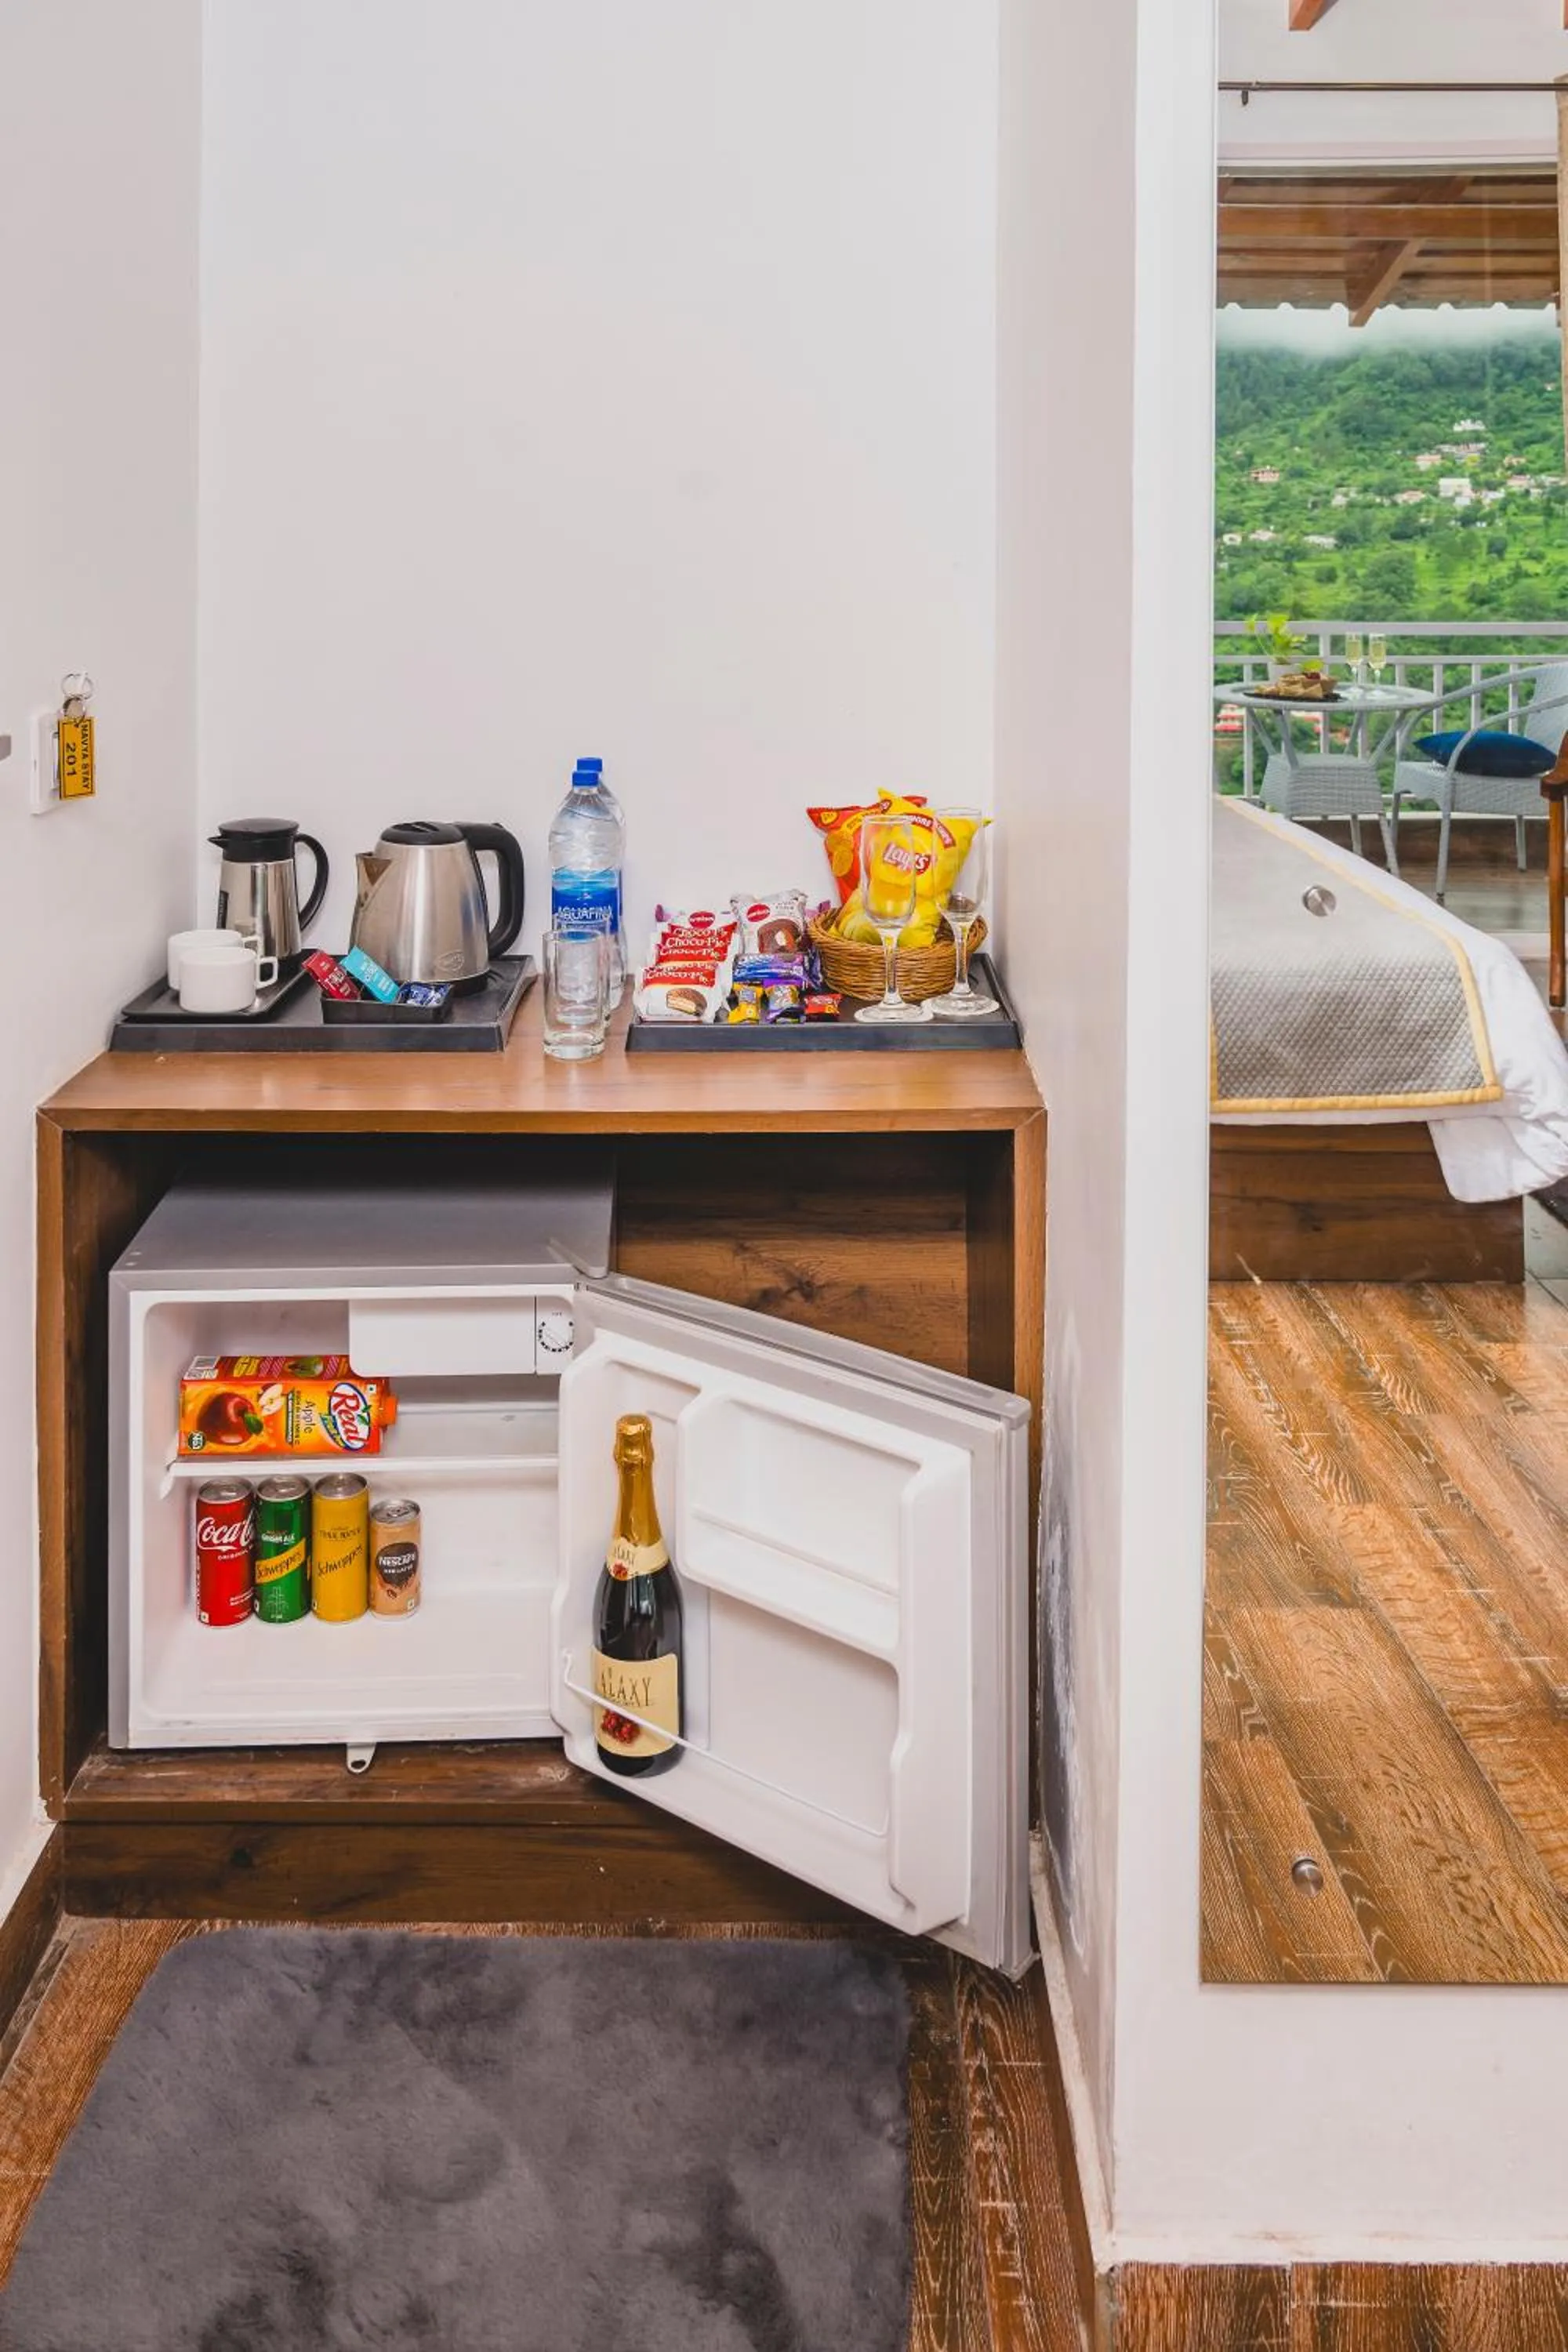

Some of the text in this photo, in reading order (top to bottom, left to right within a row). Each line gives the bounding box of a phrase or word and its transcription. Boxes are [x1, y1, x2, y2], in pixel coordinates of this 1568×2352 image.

[65, 742, 77, 776] 201
[82, 764, 90, 789] STAY
[302, 1400, 316, 1434] Apple
[256, 1550, 303, 1580] Schweppes
[318, 1543, 363, 1577] Schweppes
